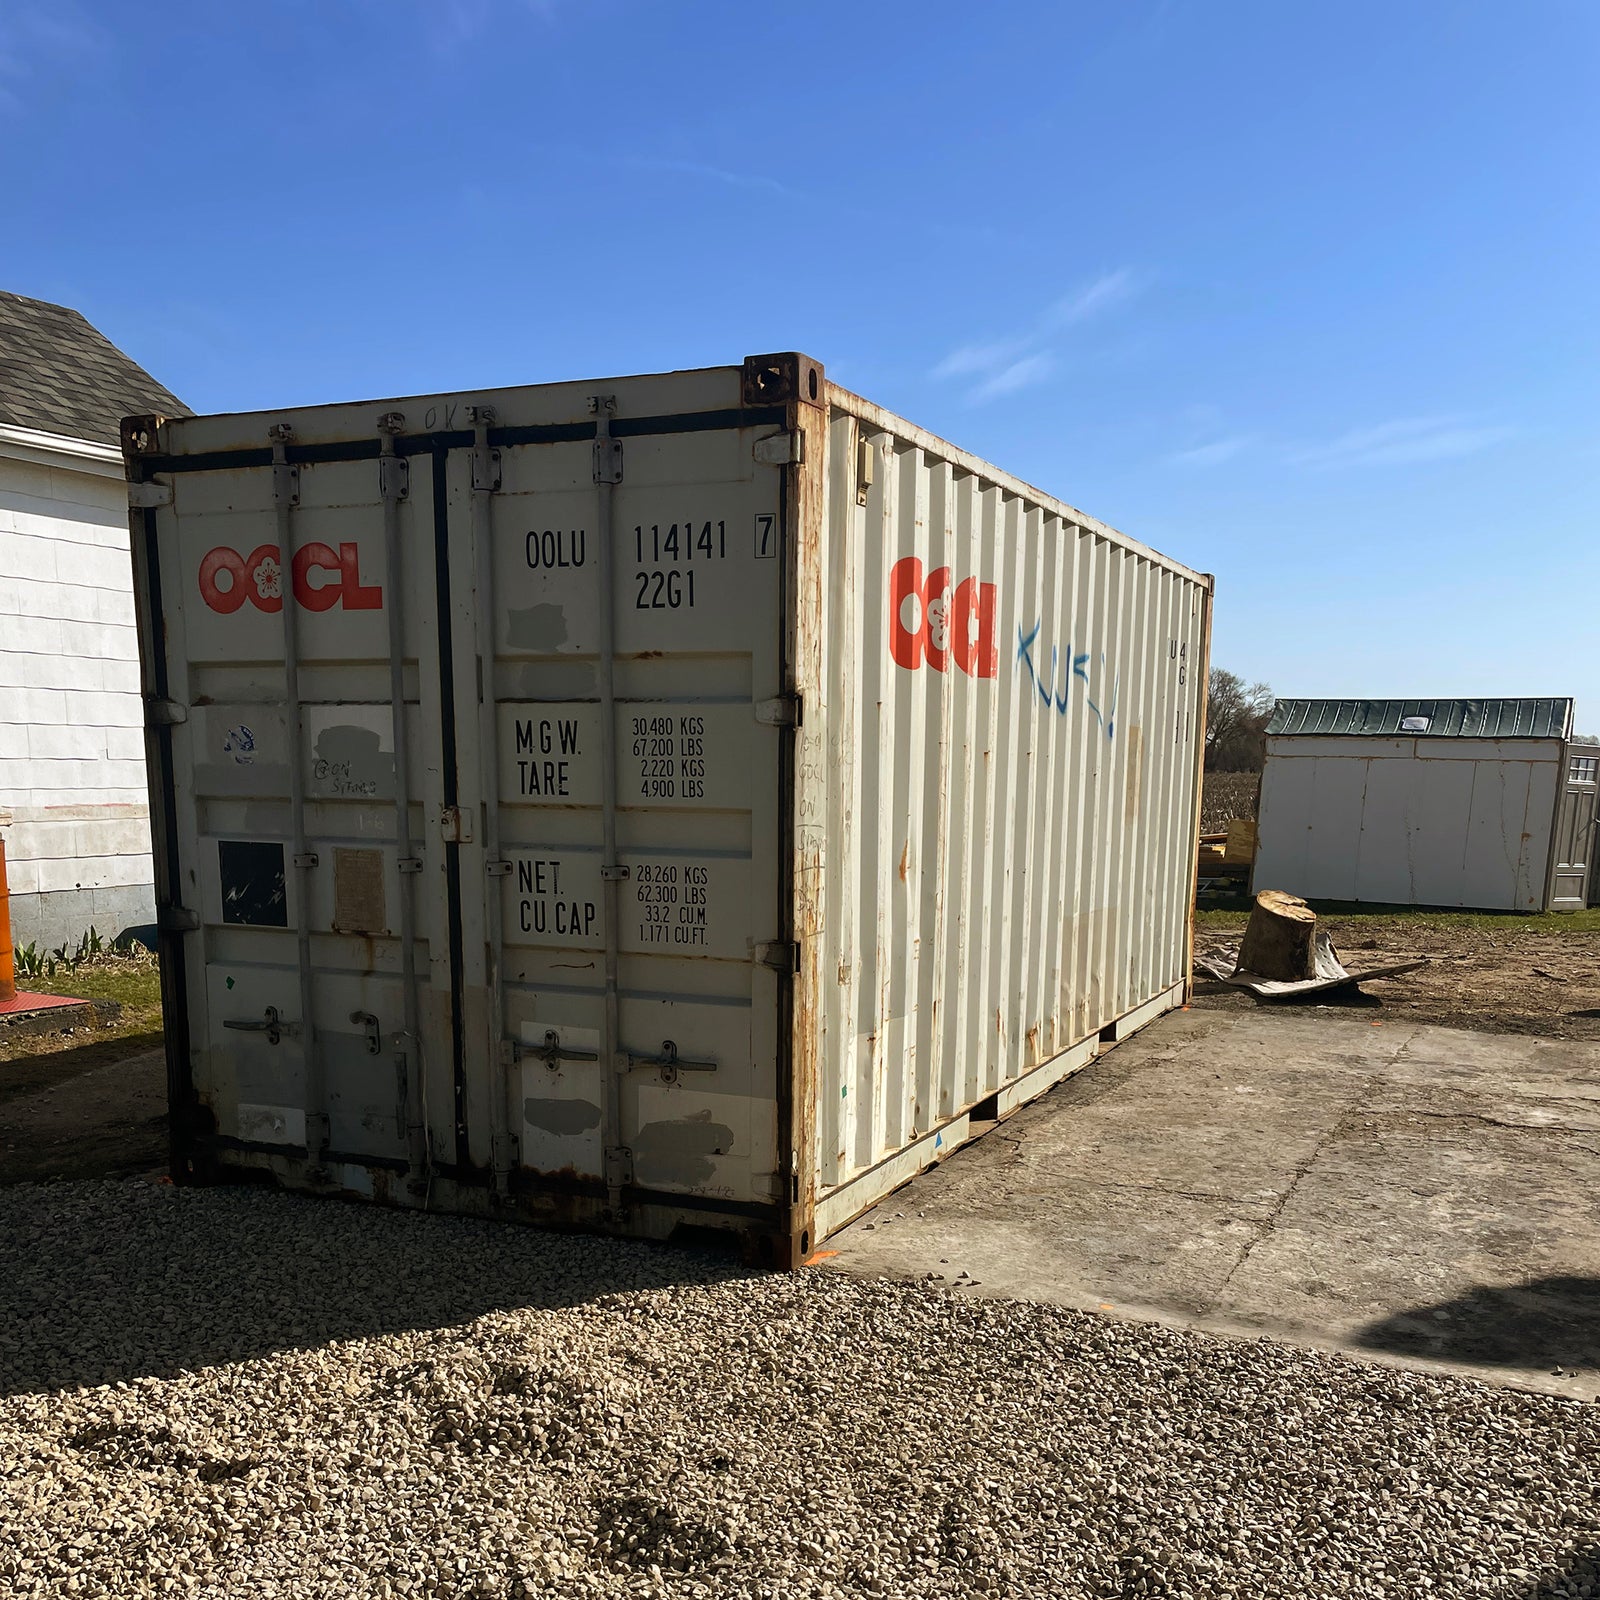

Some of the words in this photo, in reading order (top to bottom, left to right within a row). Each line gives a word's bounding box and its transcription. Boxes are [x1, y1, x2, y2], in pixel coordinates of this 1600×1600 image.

[425, 402, 458, 431] OK
[525, 530, 585, 568] OOLU
[634, 520, 726, 562] 114141
[757, 516, 773, 555] 7
[198, 542, 383, 614] OOCL
[635, 570, 694, 609] 22G1
[680, 717, 704, 736] KGS
[681, 738, 704, 757] LBS
[681, 759, 705, 777] KGS
[517, 761, 569, 795] TARE
[682, 780, 704, 798] LBS
[518, 860, 564, 895] NET.
[684, 866, 708, 884] KGS
[684, 887, 706, 905] LBS
[645, 905, 670, 922] 33.2
